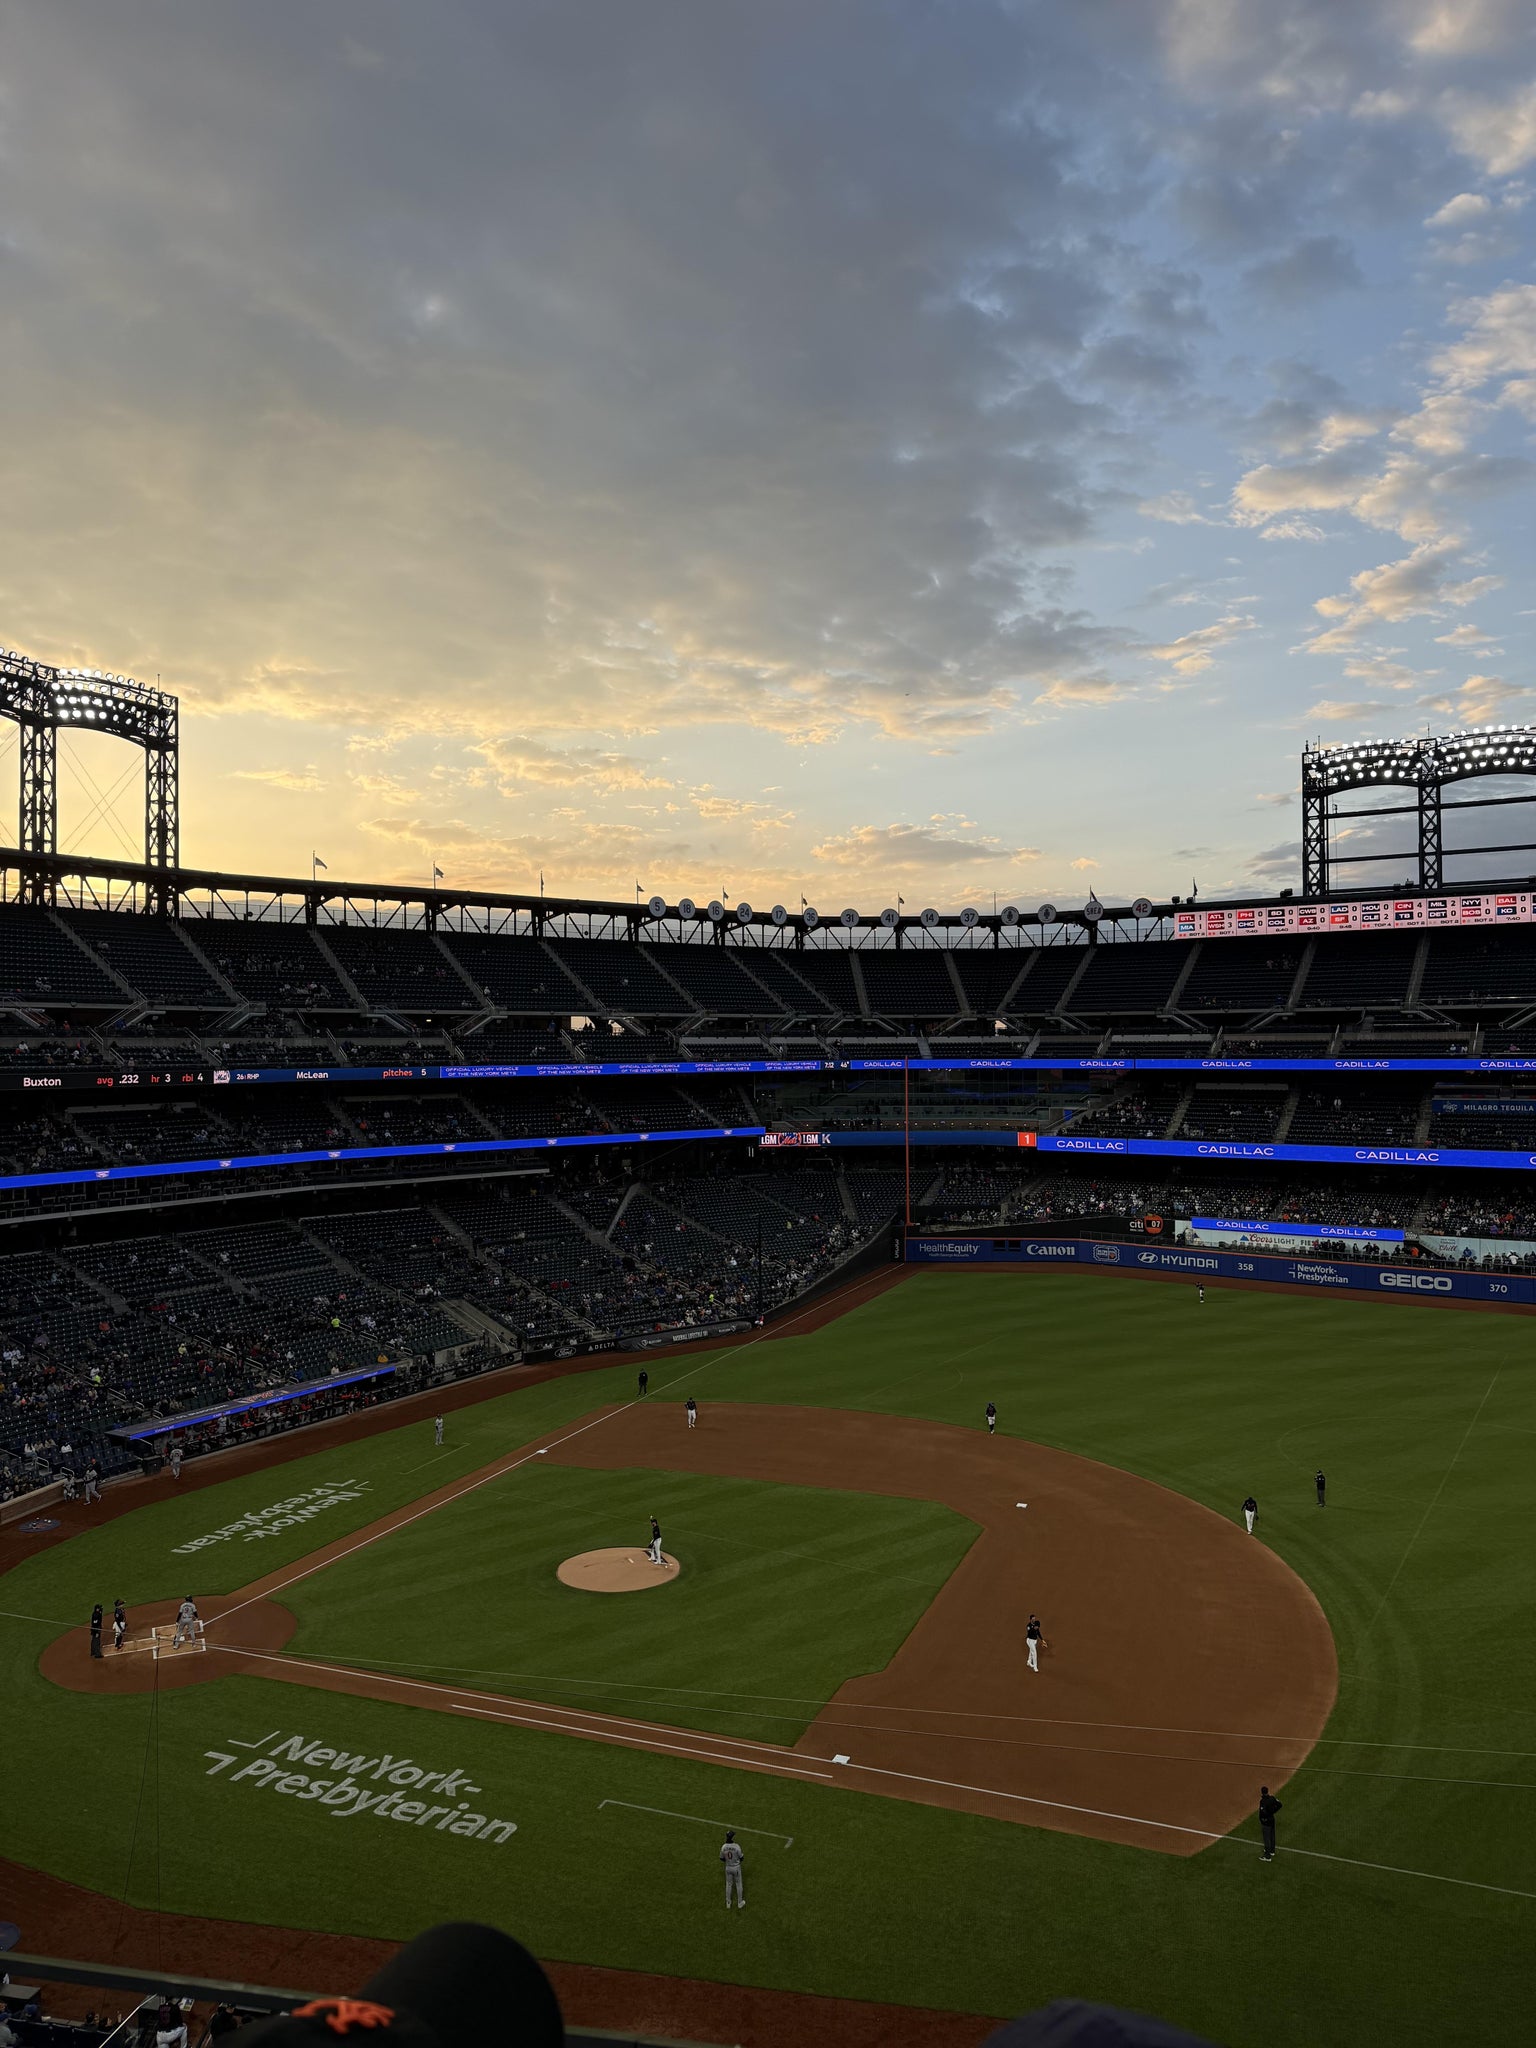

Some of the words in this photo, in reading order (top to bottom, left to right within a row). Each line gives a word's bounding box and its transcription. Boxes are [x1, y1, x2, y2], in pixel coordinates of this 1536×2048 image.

[655, 902, 660, 911] 5
[683, 904, 691, 913] 18
[712, 906, 720, 915] 16
[1087, 907, 1100, 915] SHEA
[1136, 904, 1148, 913] 42
[740, 908, 750, 917] 24
[776, 910, 783, 919] 17
[806, 913, 815, 922] 36
[846, 913, 854, 923] 31
[886, 914, 894, 923] 41
[925, 914, 934, 923] 14
[964, 913, 975, 922] 37
[182, 1074, 194, 1082] rbi
[197, 1073, 203, 1082] 4
[383, 1069, 413, 1078] pitches
[23, 1077, 62, 1087] Buxton
[97, 1076, 114, 1087] avg
[119, 1074, 139, 1084] .232
[151, 1075, 160, 1083] hr
[165, 1074, 171, 1083] 3
[761, 1135, 776, 1144] LGM
[803, 1134, 818, 1144] LGM
[822, 1134, 831, 1144] K
[1024, 1135, 1030, 1144] 1
[1056, 1140, 1124, 1150] CADILLAC
[1197, 1145, 1274, 1156] CADILLAC
[1355, 1150, 1439, 1161] CADILLAC
[1129, 1219, 1143, 1228] citi
[1216, 1221, 1269, 1230] CADILLAC
[1321, 1227, 1377, 1237] CADILLAC
[1249, 1234, 1273, 1244] Coors
[919, 1243, 979, 1254] HealthEquity
[1026, 1244, 1076, 1256] Canon
[1161, 1254, 1218, 1269] HYUNDAI
[1237, 1262, 1254, 1271] 358
[1298, 1272, 1349, 1284] Presbyterian
[1379, 1272, 1452, 1291] GEICO
[1489, 1284, 1507, 1293] 370
[171, 1488, 334, 1553] Presbyterian
[229, 1758, 518, 1843] Presbyterian
